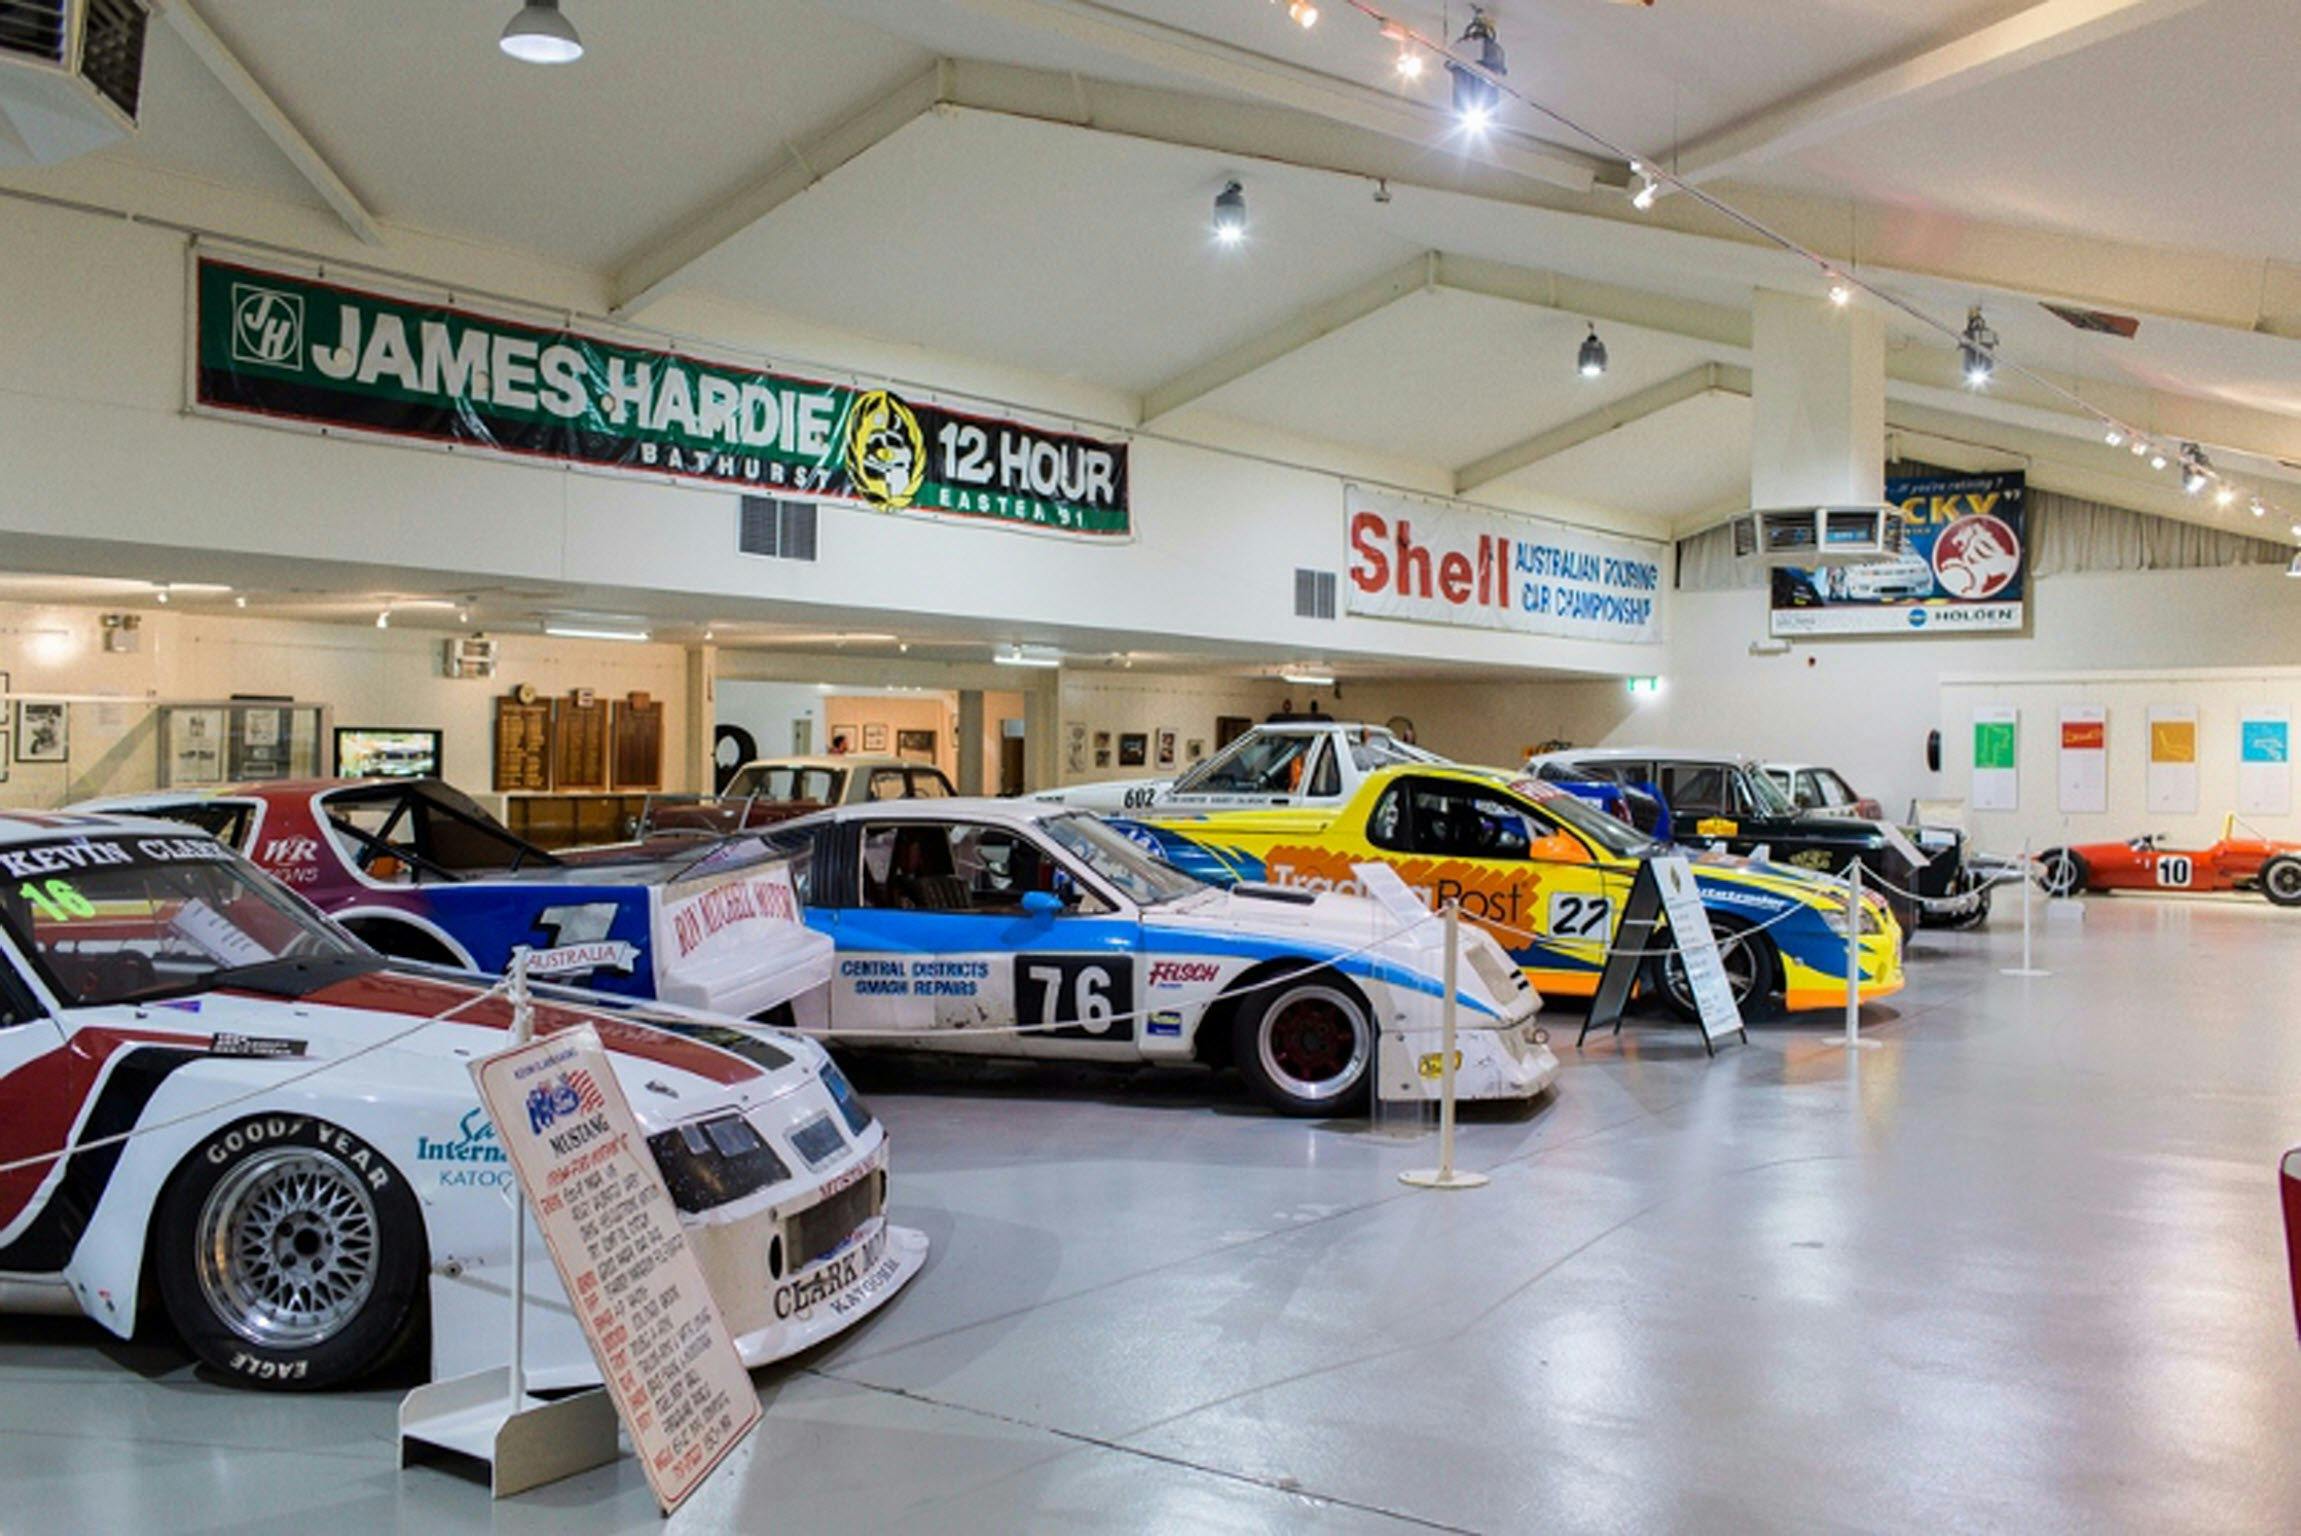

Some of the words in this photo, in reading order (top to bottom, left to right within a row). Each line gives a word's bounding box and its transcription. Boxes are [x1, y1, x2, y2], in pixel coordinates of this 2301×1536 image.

[311, 304, 588, 419] JAMES
[607, 357, 835, 457] HARDIE
[641, 442, 833, 492] BATHURST
[939, 421, 994, 484] 12
[1000, 431, 1115, 506] HOUR
[1349, 511, 1510, 610] Shell
[1515, 541, 1600, 583] AUSTRALIAN
[1603, 557, 1658, 591] TOURING
[1522, 582, 1551, 613] CAR
[1556, 587, 1651, 625] CHAMPIONSHIP
[1935, 609, 2013, 623] HOLDEN
[1123, 787, 1157, 809] 602
[0, 839, 134, 878] KEVIN
[2160, 858, 2188, 885] 10
[18, 878, 96, 922] 16
[1551, 896, 1610, 936] 27
[528, 945, 617, 969] AUSTRALIA
[841, 960, 905, 977] CENTRAL
[911, 961, 990, 979] DISTRICTS
[854, 980, 908, 995] SMASH
[913, 980, 978, 997] REPAIRS
[1028, 964, 1113, 1034] 76
[549, 1114, 611, 1157] MUSTANG
[773, 1252, 858, 1320] CLARK
[229, 1351, 309, 1380] EAGLE
